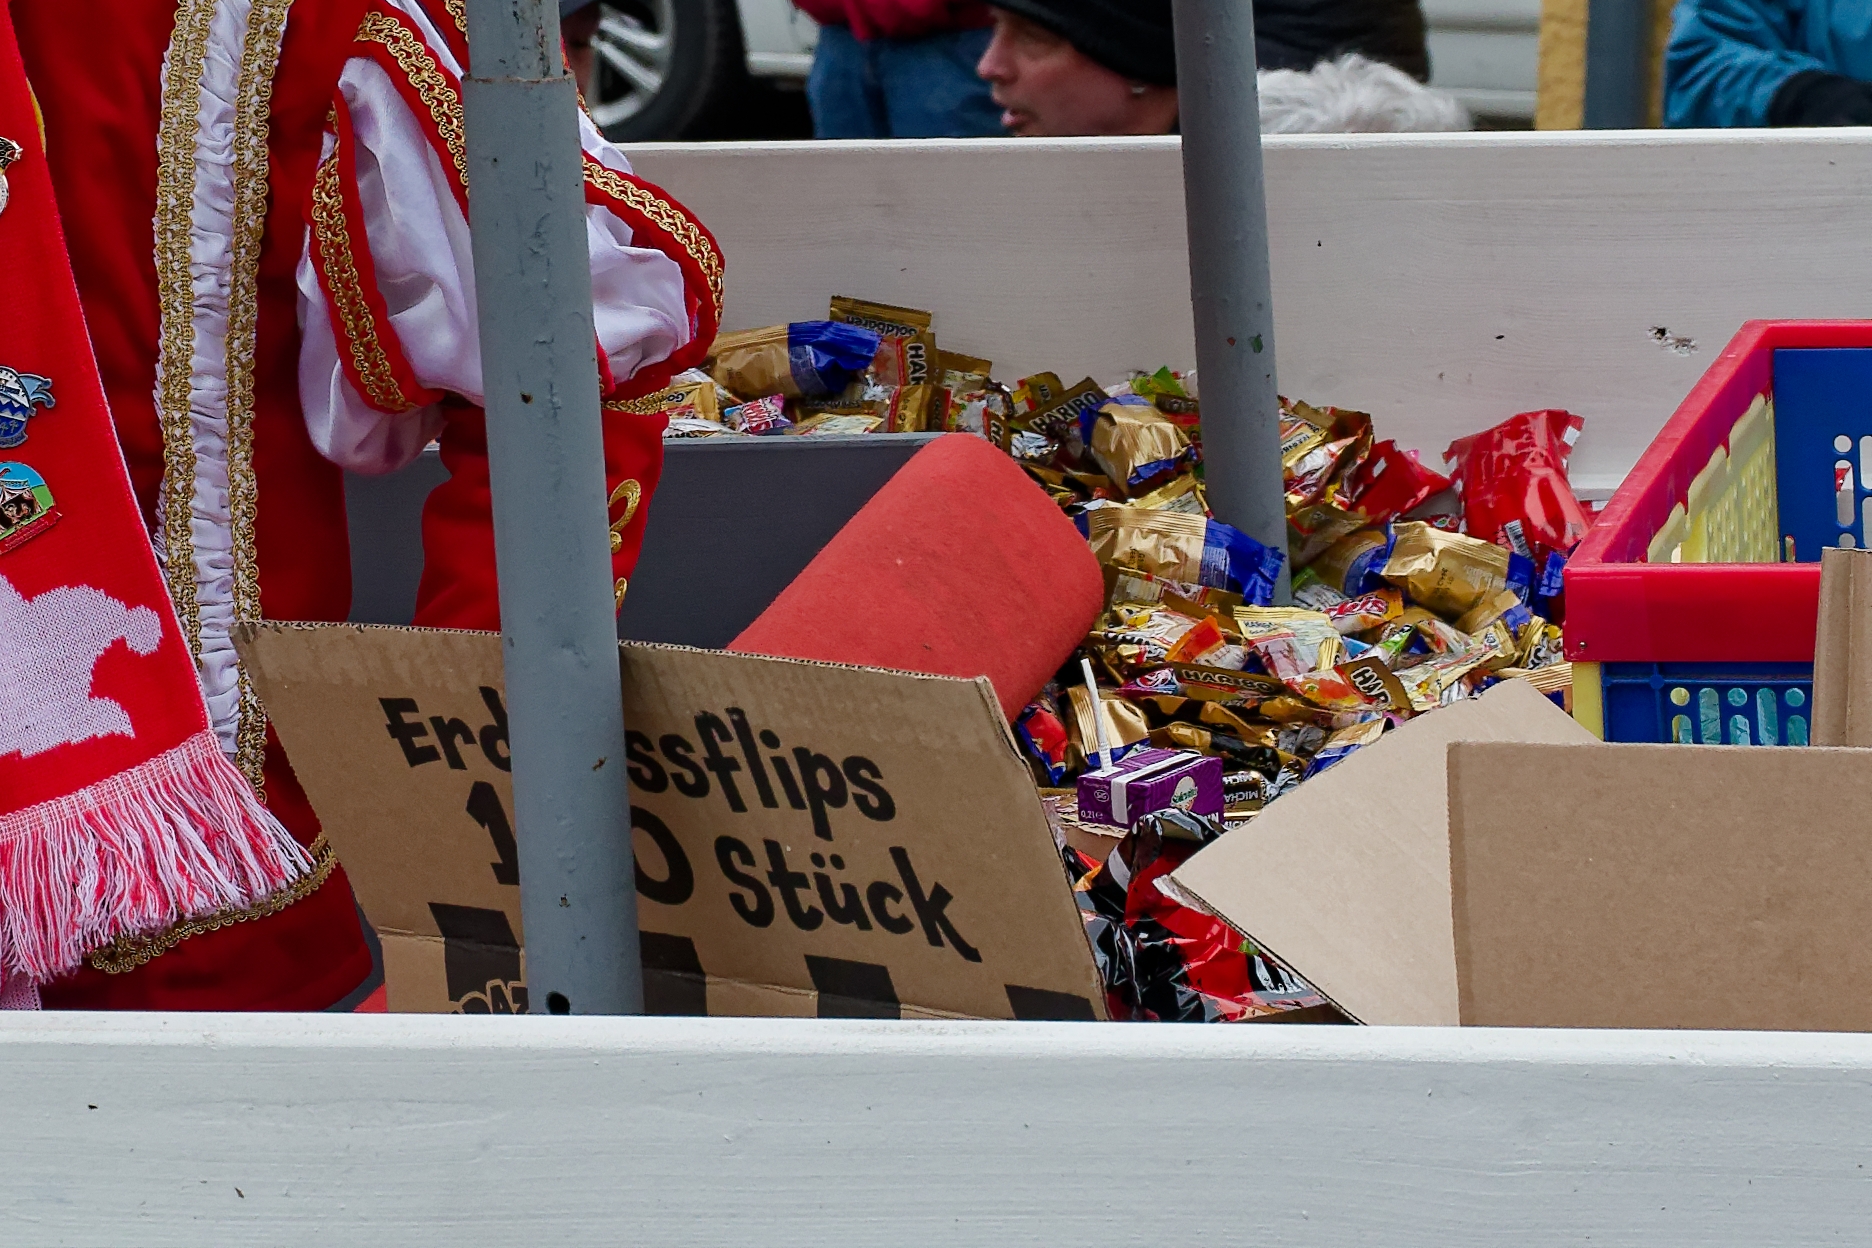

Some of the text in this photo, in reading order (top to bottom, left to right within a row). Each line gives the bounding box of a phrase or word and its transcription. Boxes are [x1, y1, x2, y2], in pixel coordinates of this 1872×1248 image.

[1029, 390, 1099, 434] HARIBO
[1181, 669, 1275, 693] HARIBO
[378, 686, 896, 841] Erdssflips
[466, 781, 695, 905] 10
[714, 835, 983, 963] Stück
